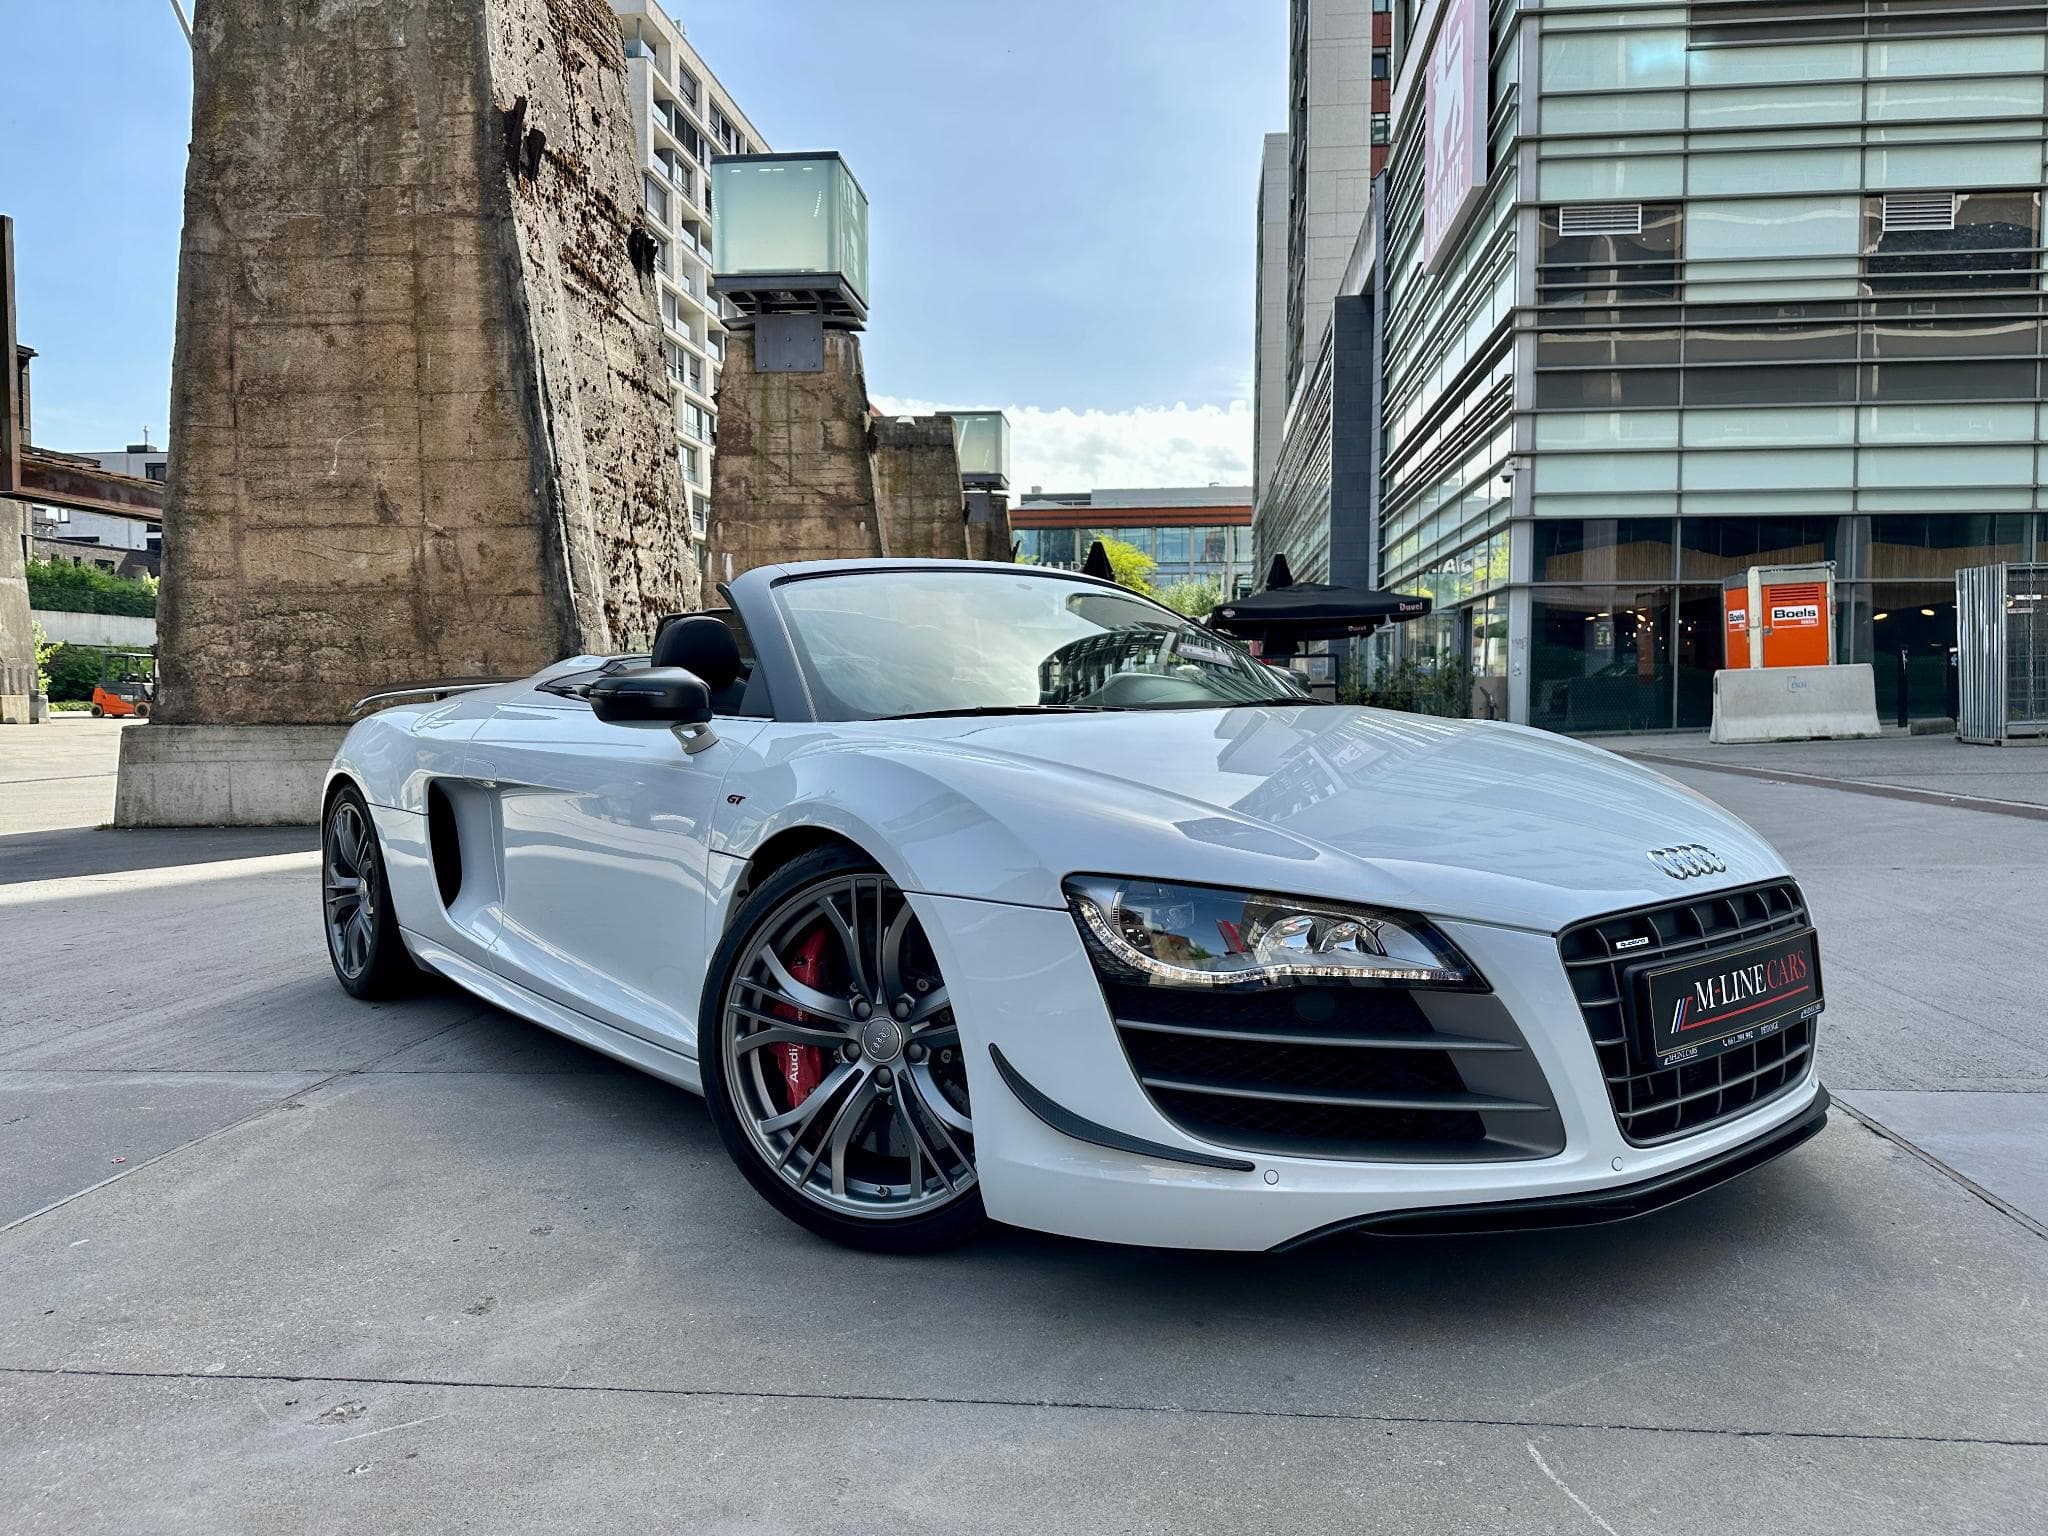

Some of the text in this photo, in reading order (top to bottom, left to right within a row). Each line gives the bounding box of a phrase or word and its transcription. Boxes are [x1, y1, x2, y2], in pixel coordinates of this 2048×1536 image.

[1399, 602, 1423, 611] Duvel
[1729, 613, 1745, 622] Boels
[1774, 608, 1816, 618] Boels
[726, 794, 746, 805] GT
[789, 1048, 799, 1084] Audi
